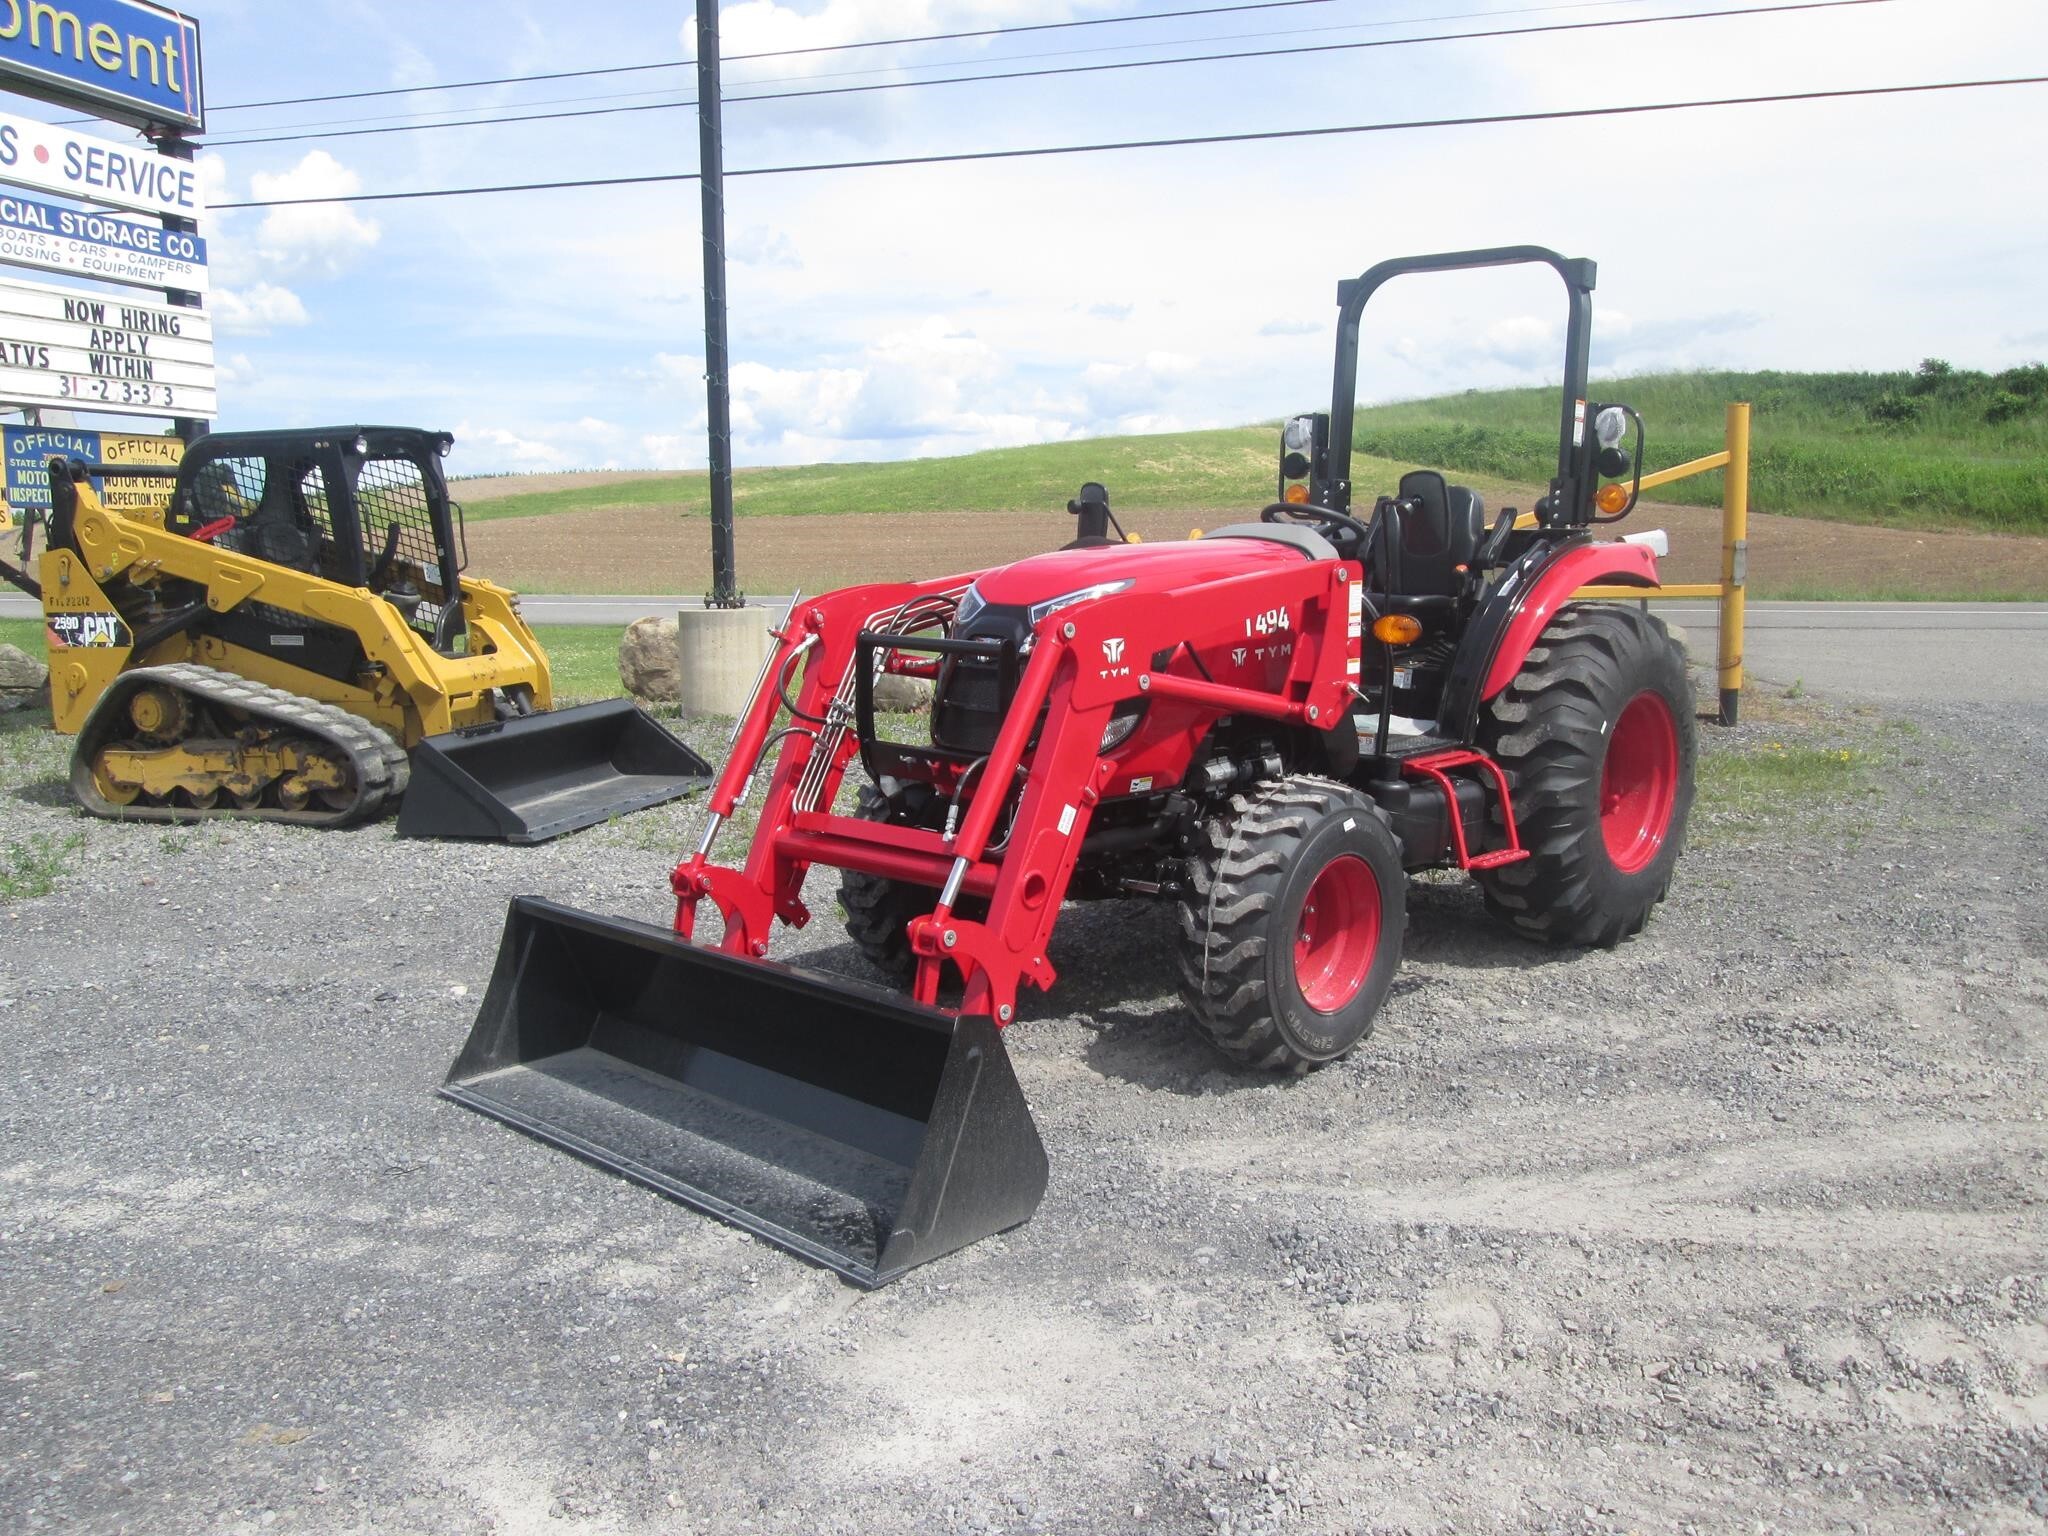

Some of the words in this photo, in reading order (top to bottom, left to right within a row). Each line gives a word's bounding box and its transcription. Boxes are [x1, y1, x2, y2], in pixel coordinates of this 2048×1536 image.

[63, 141, 195, 208] SERVICE
[60, 212, 162, 252] STORAGE
[166, 235, 200, 261] CO.
[68, 241, 108, 258] CARS
[128, 252, 193, 275] CAMPERS
[82, 257, 166, 282] EQUIPMENT
[64, 298, 105, 325] NOW
[121, 308, 181, 336] HIRING
[90, 328, 149, 355] APPLY
[89, 353, 154, 380] WITHIN
[13, 433, 95, 460] OFFICIAL
[107, 440, 179, 463] OFFICIAL
[10, 458, 37, 468] STATE
[104, 476, 138, 488] MOTOR
[104, 491, 152, 506] INSPECTION
[54, 616, 79, 630] 259D
[83, 616, 117, 647] CAT
[1255, 643, 1291, 660] TYM
[1099, 666, 1129, 680] TYM
